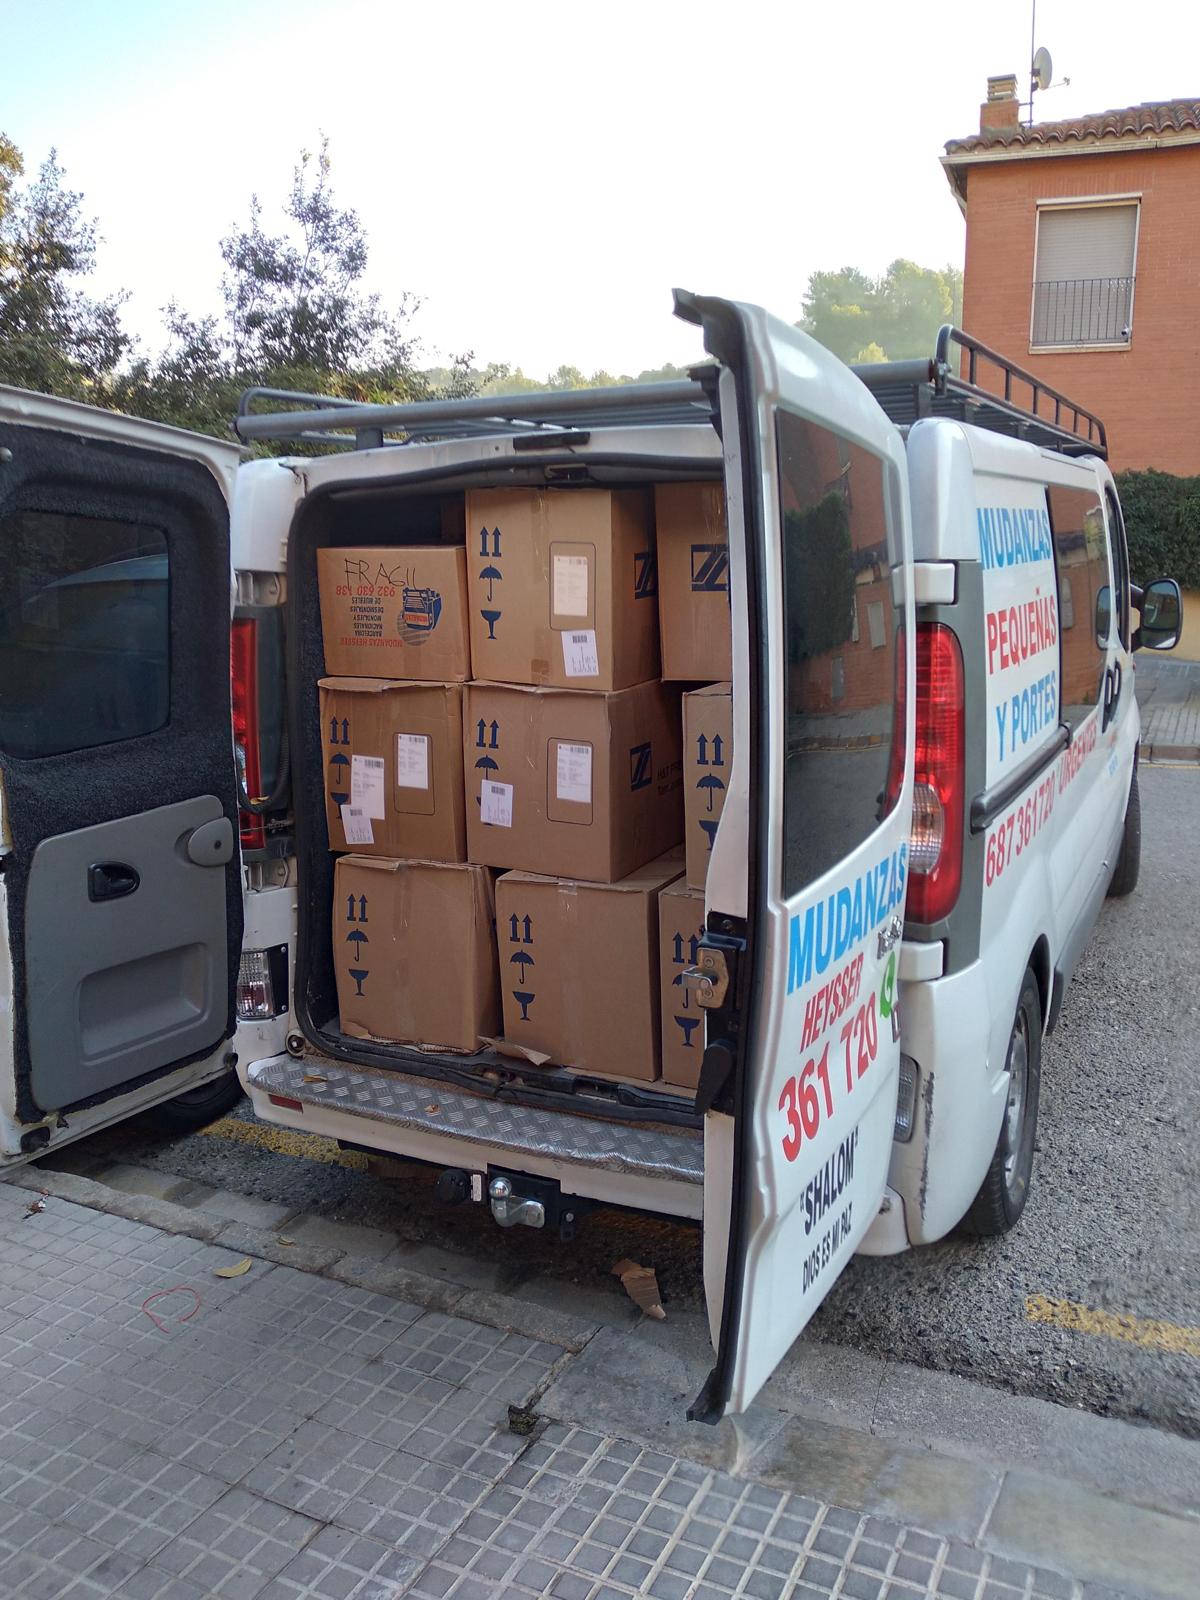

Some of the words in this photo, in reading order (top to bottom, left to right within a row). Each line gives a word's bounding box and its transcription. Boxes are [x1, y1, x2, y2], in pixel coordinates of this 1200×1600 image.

[977, 507, 1051, 571] MUDANZAS
[356, 585, 374, 597] 630
[377, 586, 396, 597] 932
[986, 587, 1057, 675] PEQUEÑAS
[996, 701, 1008, 762] Y
[1011, 670, 1057, 752] PORTES
[787, 843, 908, 995] MUDANZAS
[800, 952, 864, 1054] HEYSSER
[778, 1041, 834, 1162] 361
[840, 991, 878, 1094] 720
[802, 1243, 820, 1294] DIOS
[821, 1229, 831, 1269] ES
